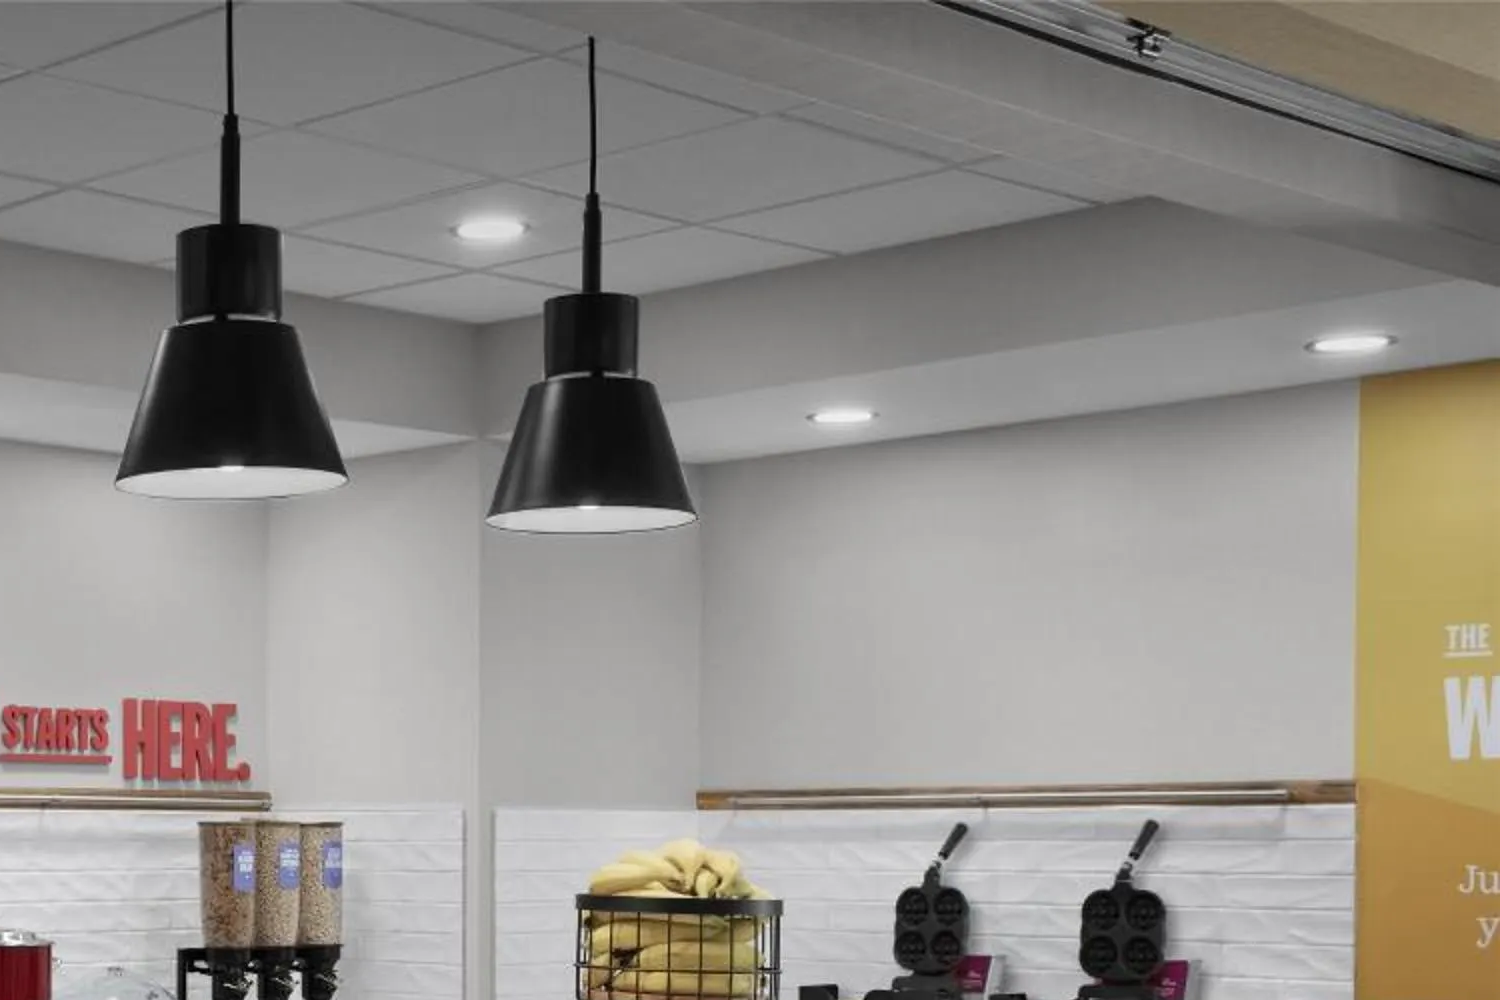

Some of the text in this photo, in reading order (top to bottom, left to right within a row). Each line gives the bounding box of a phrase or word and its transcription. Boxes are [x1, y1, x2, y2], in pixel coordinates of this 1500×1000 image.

[1444, 623, 1492, 650] THE
[1, 704, 110, 753] STARTS
[122, 698, 251, 782] HERE.
